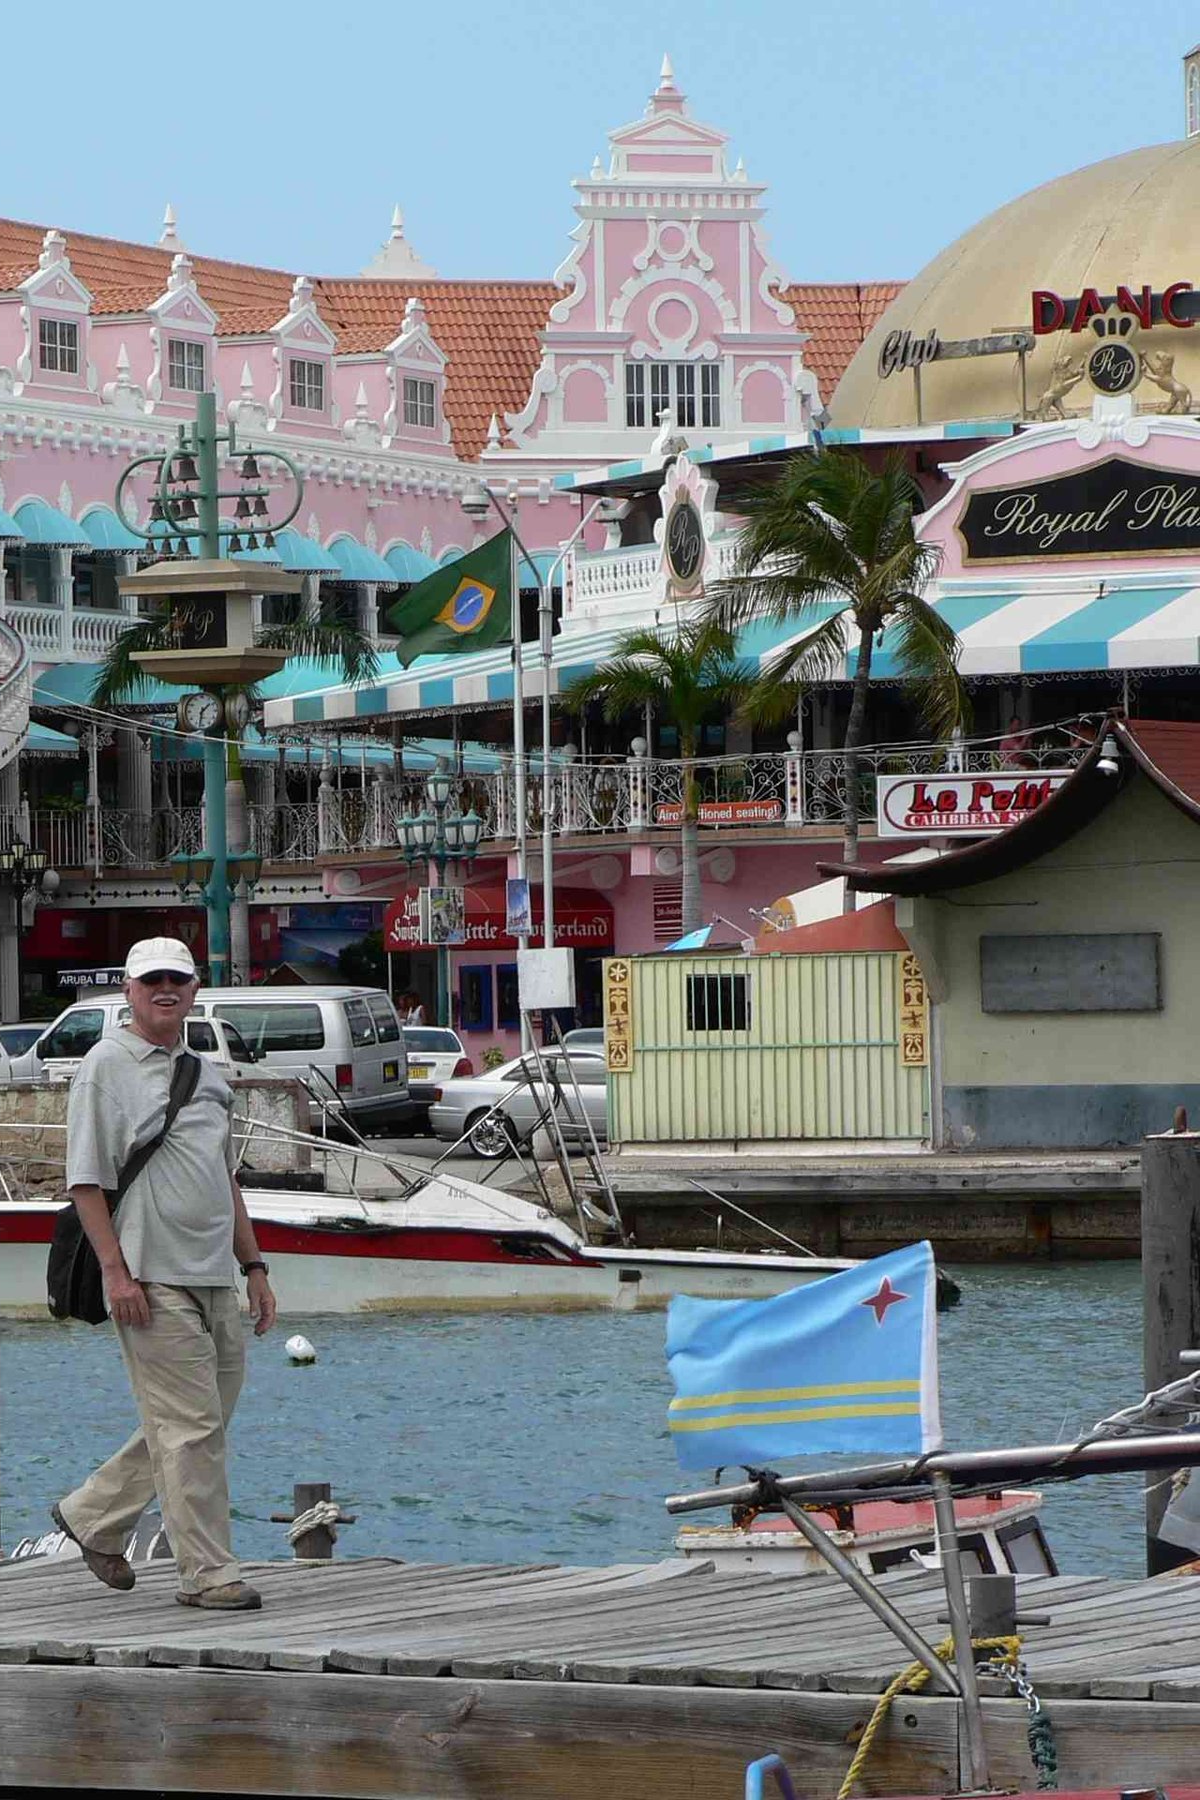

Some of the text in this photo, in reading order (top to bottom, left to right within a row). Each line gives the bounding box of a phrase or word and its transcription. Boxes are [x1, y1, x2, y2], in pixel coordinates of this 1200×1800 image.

[878, 328, 940, 379] Club
[984, 484, 1200, 549] Royal Pla
[908, 783, 958, 812] Le
[736, 804, 778, 820] seating!
[910, 812, 1000, 826] CARIBBEAN
[464, 920, 498, 940] ittle
[60, 975, 94, 985] ARUBA
